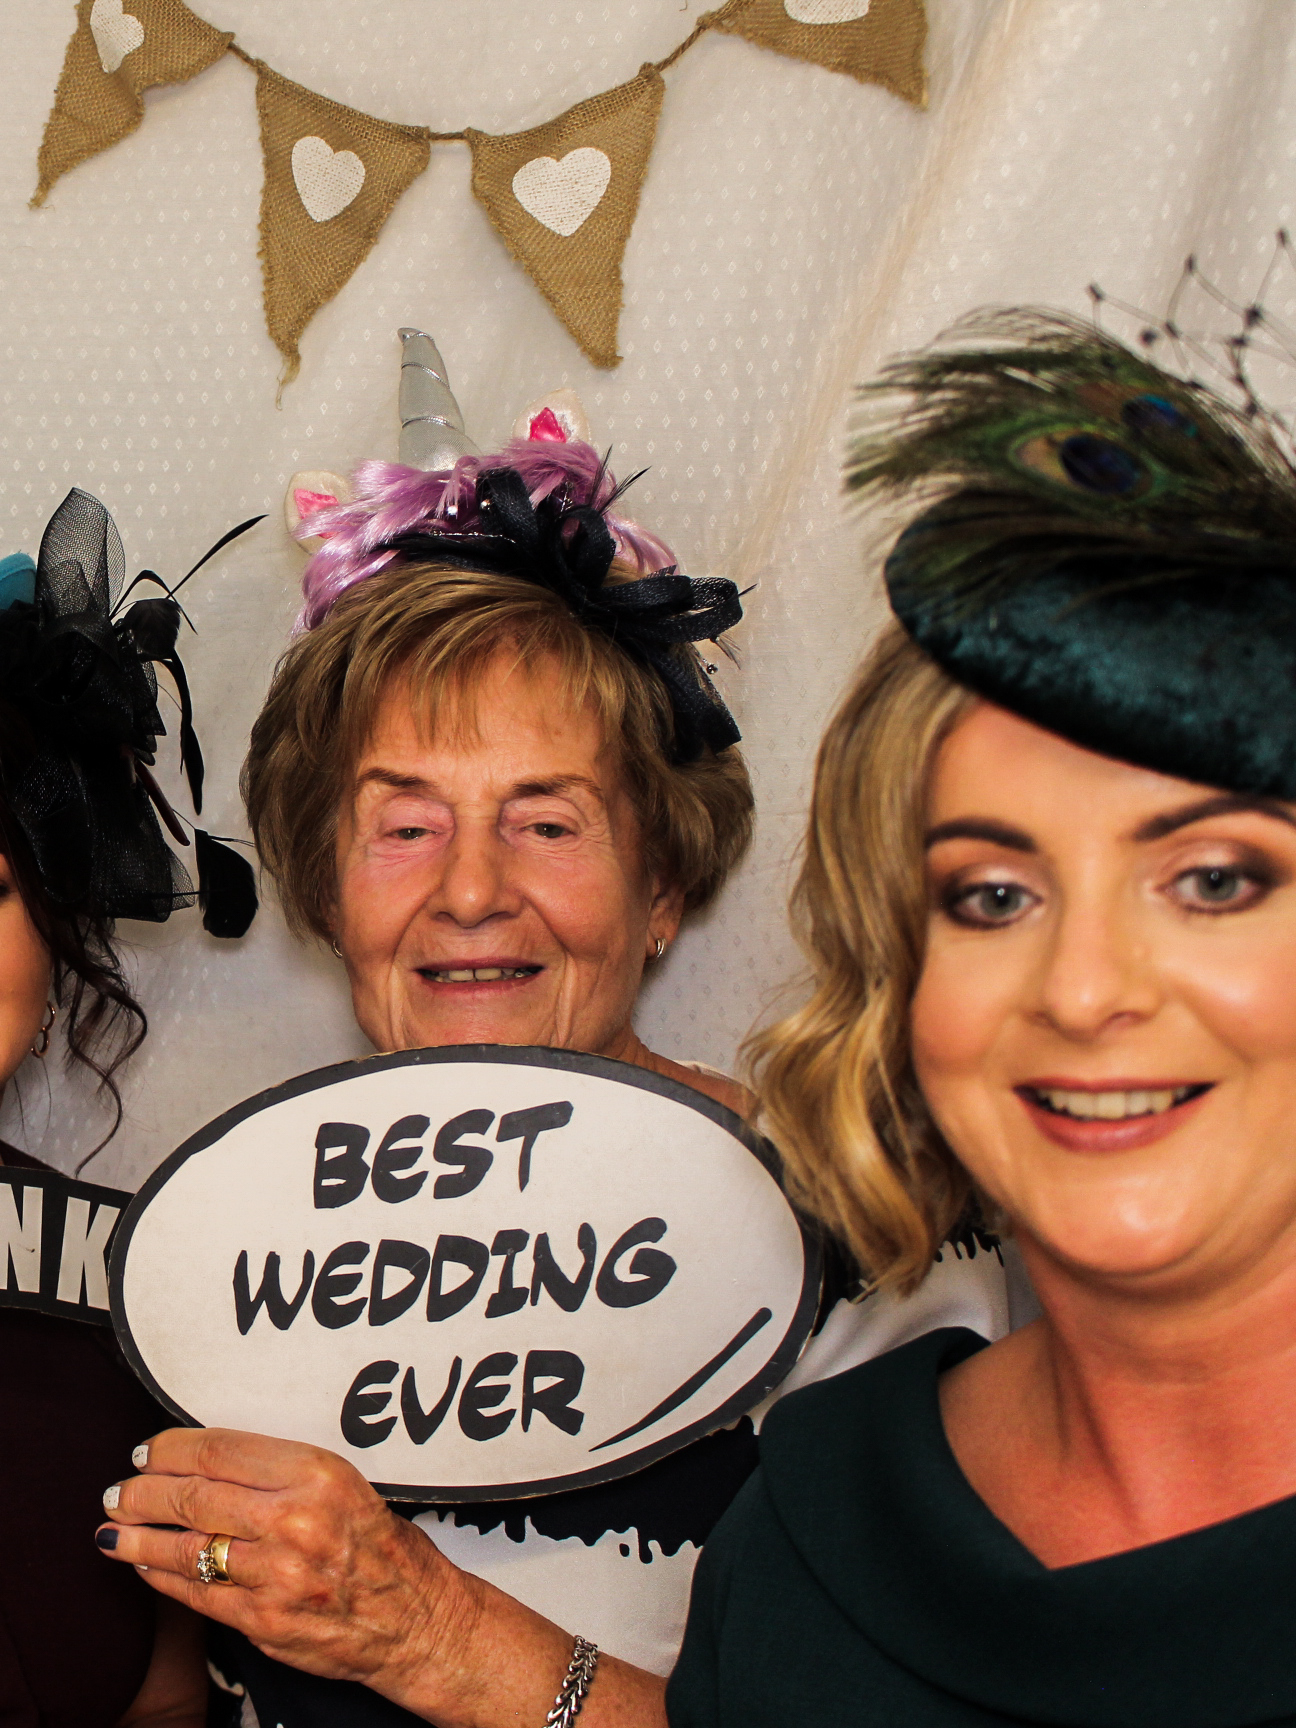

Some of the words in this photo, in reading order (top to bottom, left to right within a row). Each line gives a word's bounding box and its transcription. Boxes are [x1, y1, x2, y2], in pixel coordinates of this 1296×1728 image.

[313, 1101, 573, 1209] BEST
[232, 1217, 677, 1335] WEDDING
[340, 1350, 585, 1448] EVER
